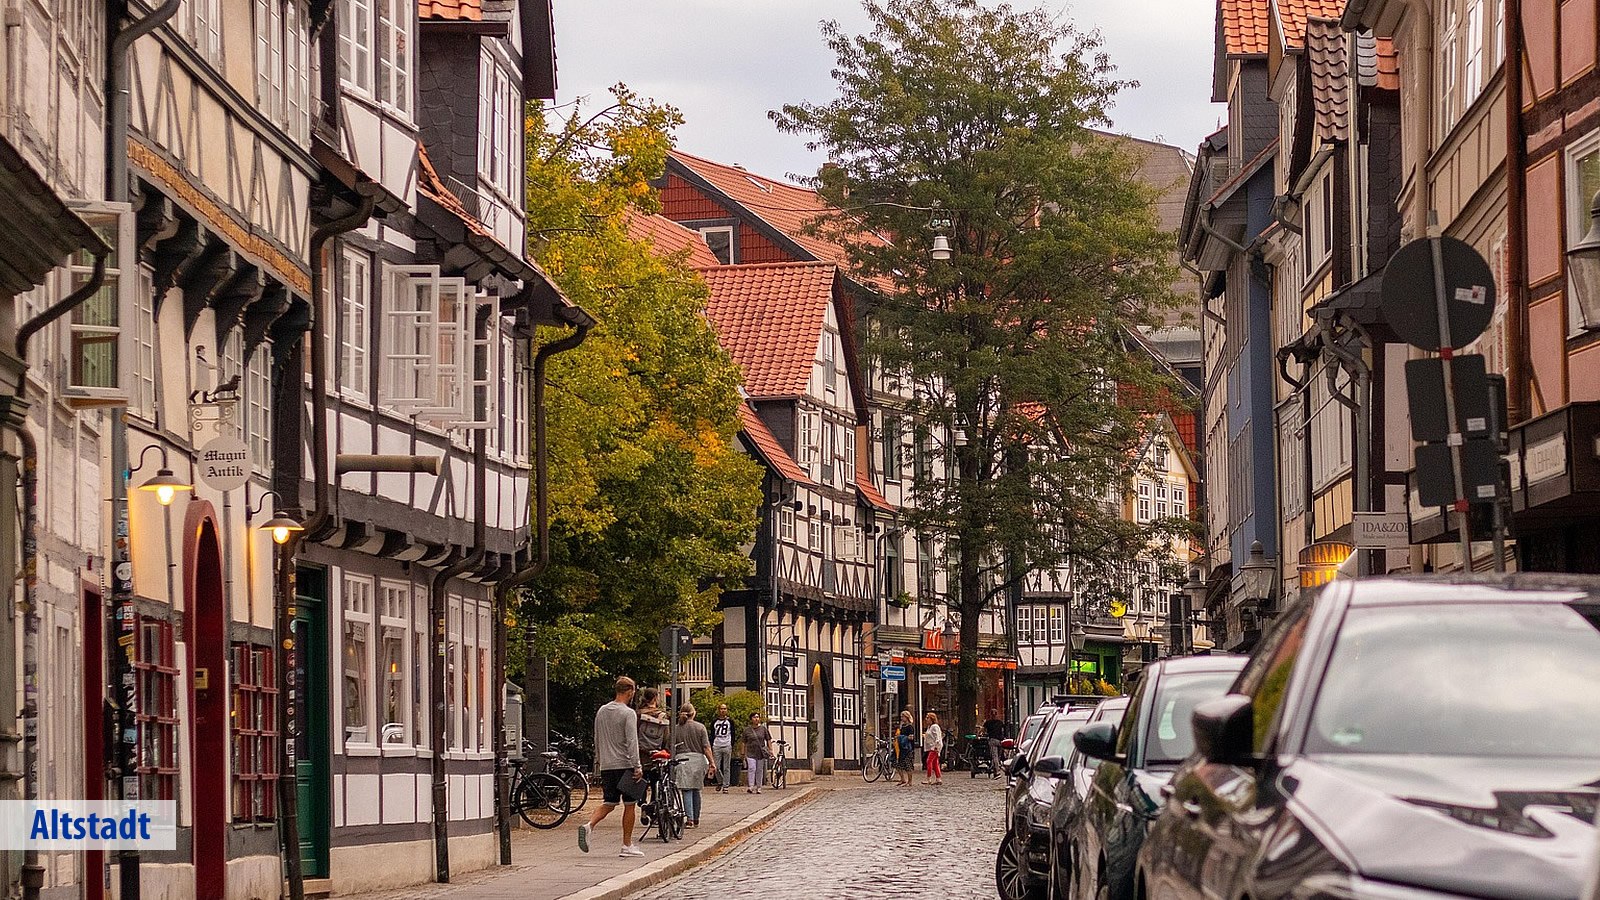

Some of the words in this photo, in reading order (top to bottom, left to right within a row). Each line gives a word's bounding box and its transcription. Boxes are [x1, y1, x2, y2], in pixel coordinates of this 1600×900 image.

[204, 449, 246, 463] Magni
[207, 465, 243, 477] Antik
[716, 723, 728, 735] 78
